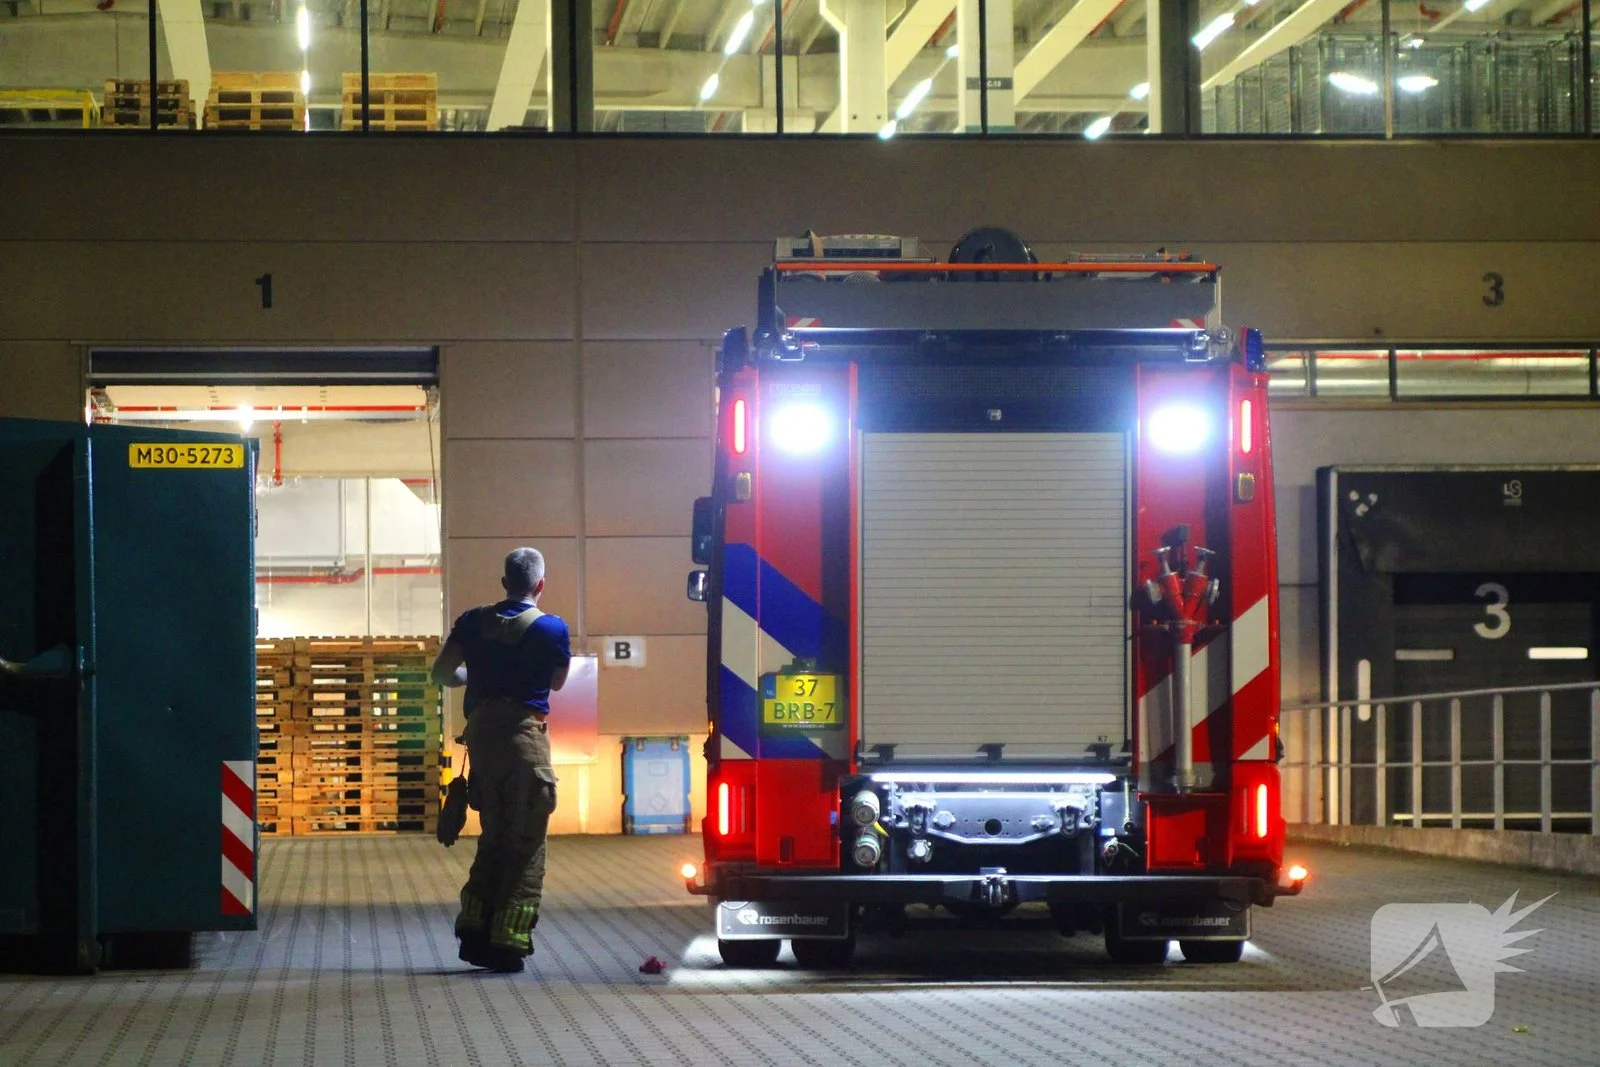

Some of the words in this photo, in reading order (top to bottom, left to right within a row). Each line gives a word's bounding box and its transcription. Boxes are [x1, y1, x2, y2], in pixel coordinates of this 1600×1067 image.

[255, 273, 272, 309] 1
[1482, 271, 1504, 307] 3
[137, 447, 234, 465] M30-5273
[1473, 582, 1512, 640] 3
[614, 641, 632, 660] B
[794, 679, 819, 697] 37
[774, 702, 836, 720] BRB-7
[760, 913, 830, 926] rosenbauer
